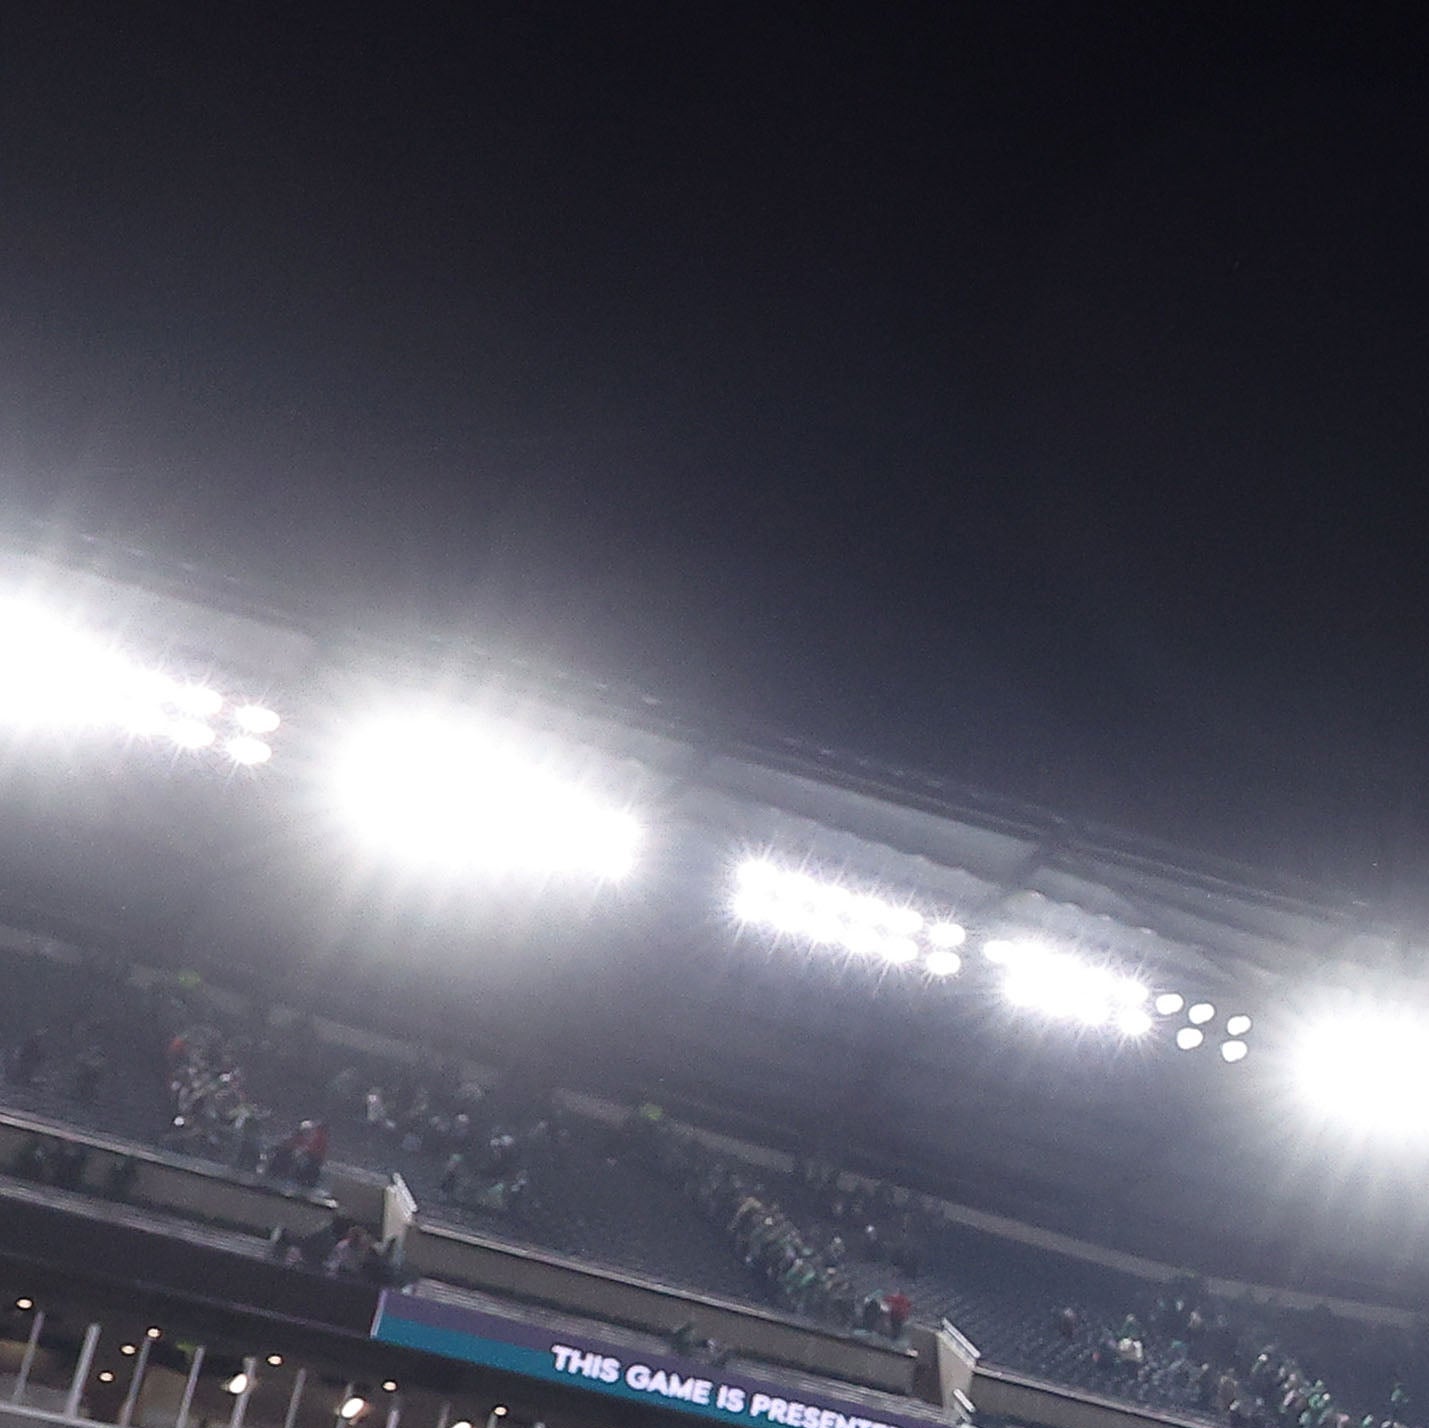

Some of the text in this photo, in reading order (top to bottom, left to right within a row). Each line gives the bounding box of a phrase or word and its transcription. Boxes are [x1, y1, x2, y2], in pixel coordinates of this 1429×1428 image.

[551, 1344, 620, 1385] THIS
[625, 1363, 712, 1406] GAME
[716, 1384, 746, 1414] IS
